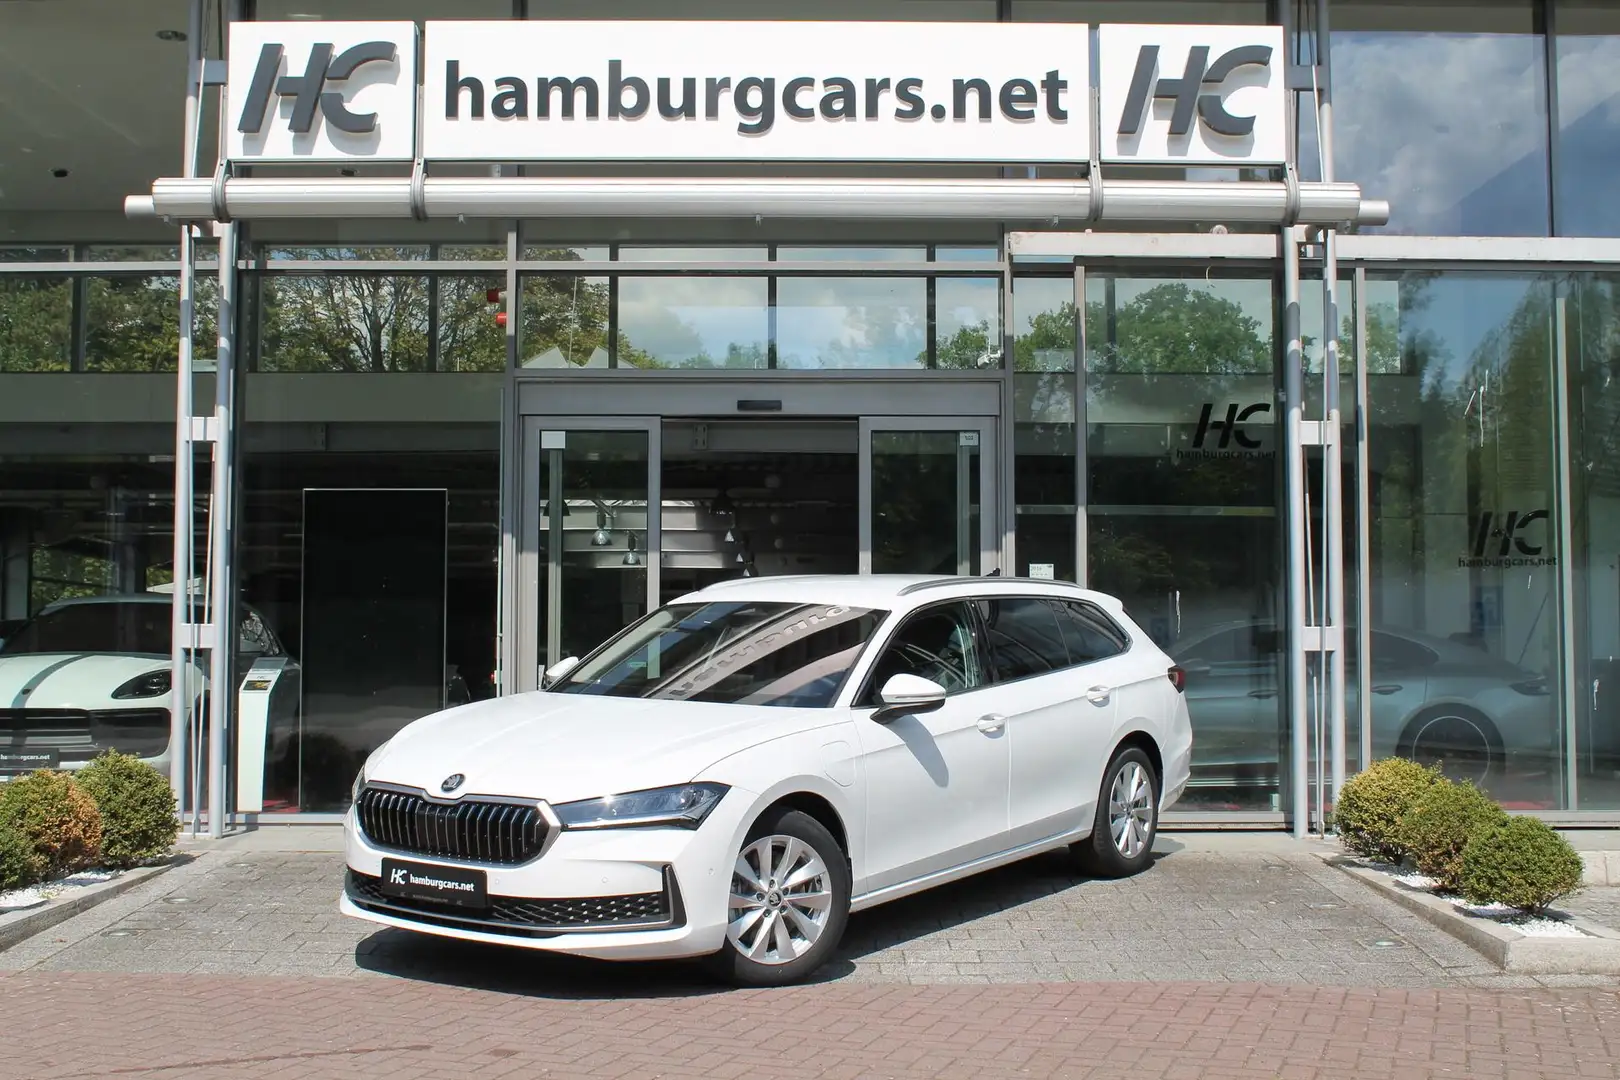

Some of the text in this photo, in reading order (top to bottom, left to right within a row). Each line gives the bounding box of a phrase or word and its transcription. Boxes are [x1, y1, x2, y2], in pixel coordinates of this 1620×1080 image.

[237, 41, 398, 134] HC
[444, 59, 1068, 135] hamburgcars.net
[1116, 45, 1274, 136] HC
[1192, 402, 1272, 449] HC
[1176, 448, 1276, 461] hamburgcars.net
[1474, 509, 1550, 556] HC
[1458, 556, 1558, 569] hamburgcars.net
[390, 868, 475, 892] HC hamburgcars.net
